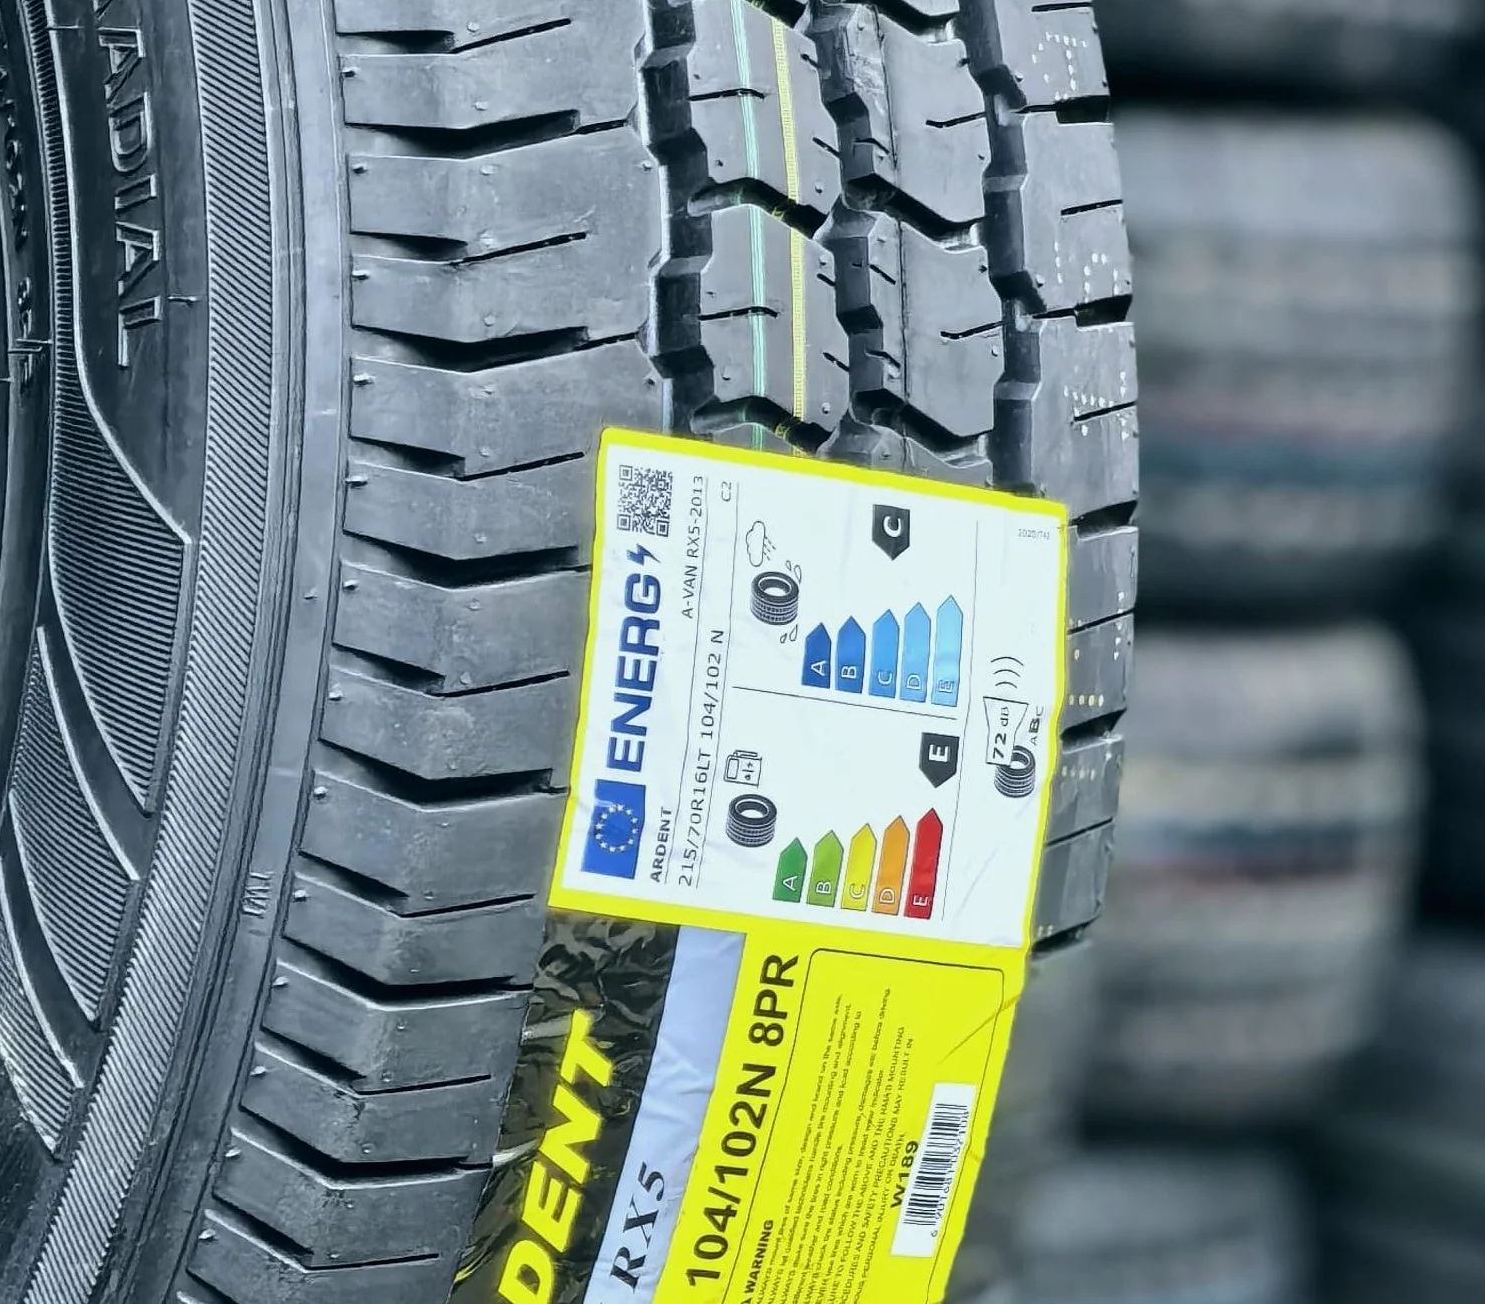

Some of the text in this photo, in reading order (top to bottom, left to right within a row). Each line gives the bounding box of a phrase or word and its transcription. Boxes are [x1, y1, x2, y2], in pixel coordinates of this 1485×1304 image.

[720, 481, 732, 502] C2
[883, 515, 902, 538] C
[682, 476, 704, 619] A-VAN RX5-2013
[606, 573, 661, 772] ENERG
[811, 660, 827, 677] A
[841, 665, 857, 679] B
[878, 670, 893, 686] C
[906, 673, 922, 691] D
[938, 680, 955, 693] E
[992, 705, 1009, 760] 72 dB
[678, 630, 724, 887] 215/70R16LT 104/102 N
[928, 744, 949, 763] E
[650, 807, 672, 883] ARDENT
[782, 875, 797, 891] A
[816, 881, 831, 895] B
[849, 883, 866, 899] C
[879, 887, 895, 904] D
[913, 895, 929, 907] E
[685, 1062, 777, 1287] 104/102N
[747, 953, 802, 1048] 8PR
[889, 1141, 918, 1207] W189
[610, 1161, 668, 1291] RX5
[743, 1220, 774, 1293] WARNING
